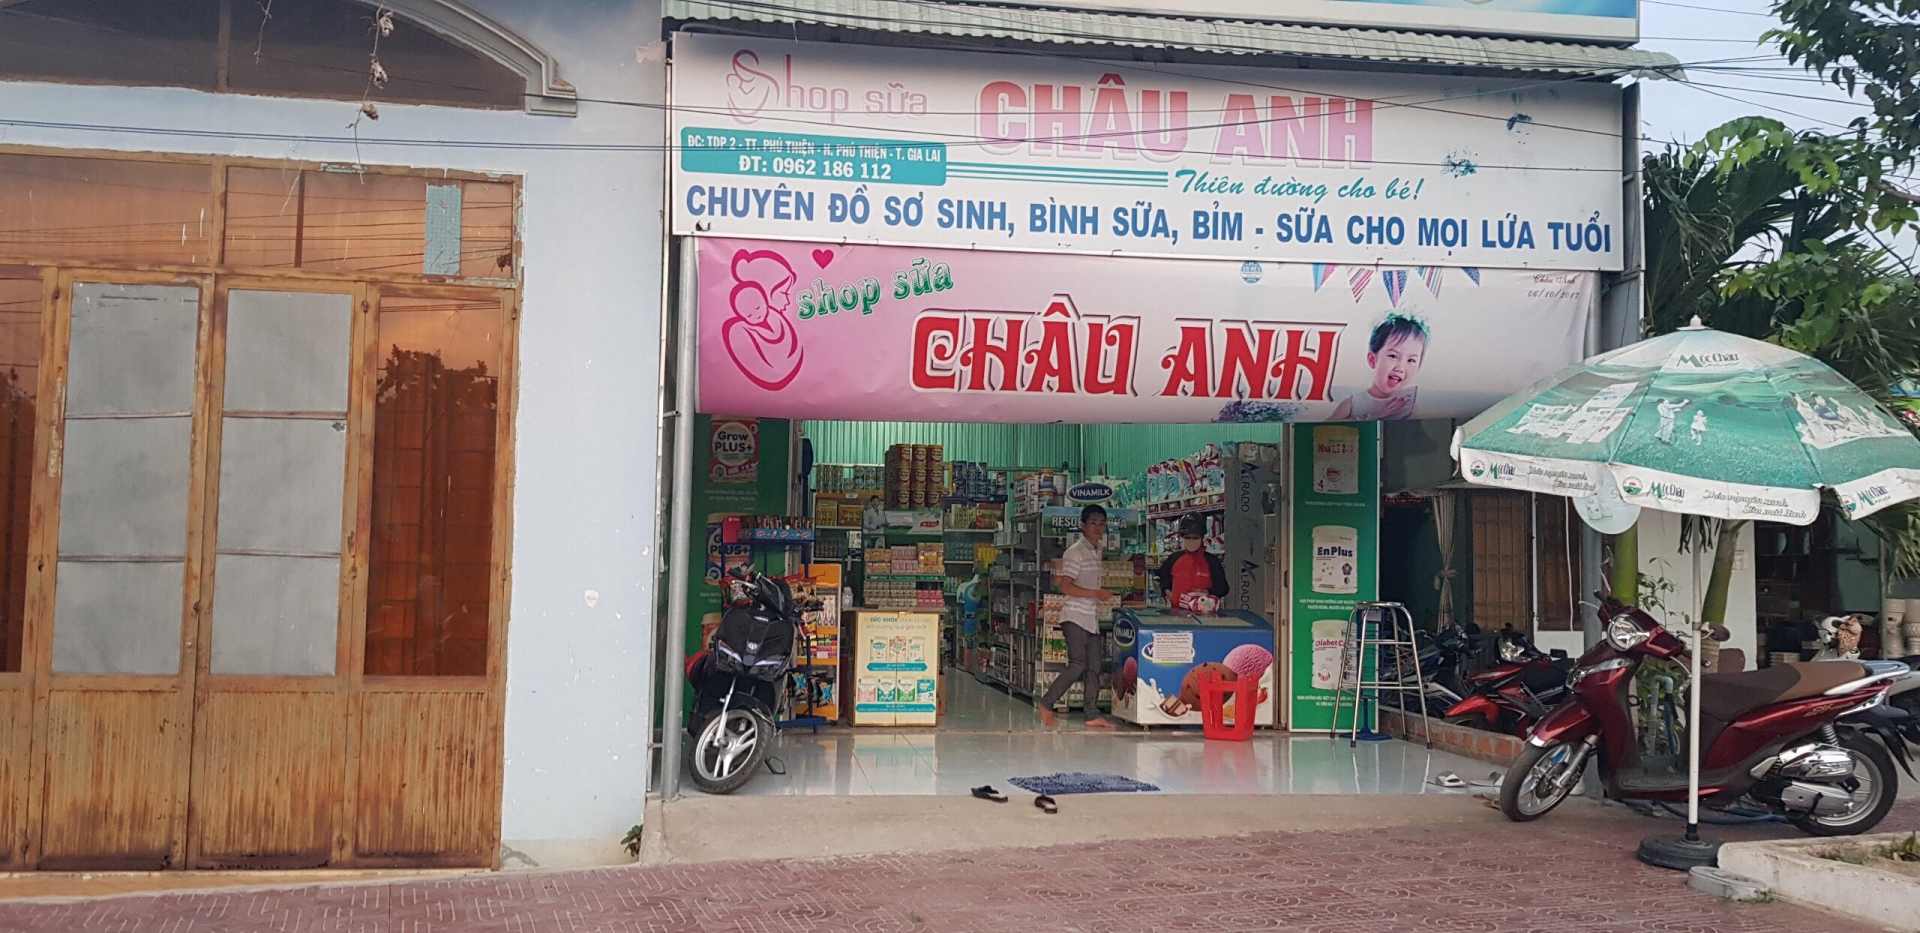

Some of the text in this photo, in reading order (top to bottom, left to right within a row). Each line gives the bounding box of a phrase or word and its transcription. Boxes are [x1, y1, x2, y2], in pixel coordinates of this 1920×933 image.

[864, 83, 928, 117] sữa
[977, 73, 1374, 167] CHÂU ANH
[687, 134, 705, 148] ĐC:
[707, 136, 727, 149] TDP
[729, 137, 736, 150] 2
[745, 138, 760, 150] TT.
[763, 138, 783, 153] PHÚ
[785, 138, 815, 156] THIỆN
[836, 141, 856, 157] PHÚ
[859, 143, 887, 160] THIỆN
[896, 148, 905, 161] T.
[907, 148, 923, 162] GIA
[925, 149, 941, 162] LAI
[739, 155, 892, 180] ĐT: 0962 186 112
[1175, 169, 1425, 204] Thiên đường cho bé!
[686, 183, 815, 221] CHUYÊN
[828, 184, 870, 224] ĐỒ
[883, 191, 924, 227] SƠ
[936, 197, 1016, 238] SINH,
[1029, 196, 1100, 236] BÌNH
[1112, 201, 1179, 246] SỮA,
[1192, 200, 1243, 241] BỈM
[1276, 207, 1334, 244] SỮA
[1346, 215, 1405, 246] CHO
[1418, 218, 1468, 256] MỌI
[1481, 211, 1536, 250] LỨA
[1547, 211, 1612, 253] TUỔI
[796, 257, 955, 320] shop sữa
[1527, 288, 1580, 299] 06/10/2017
[911, 295, 1345, 401] CHÂU ANH
[714, 441, 753, 453] PLUS+
[718, 431, 748, 441] Grow
[1071, 488, 1111, 497] VINAMILK
[1317, 546, 1353, 557] EnPlus
[1315, 639, 1338, 647] Diabet
